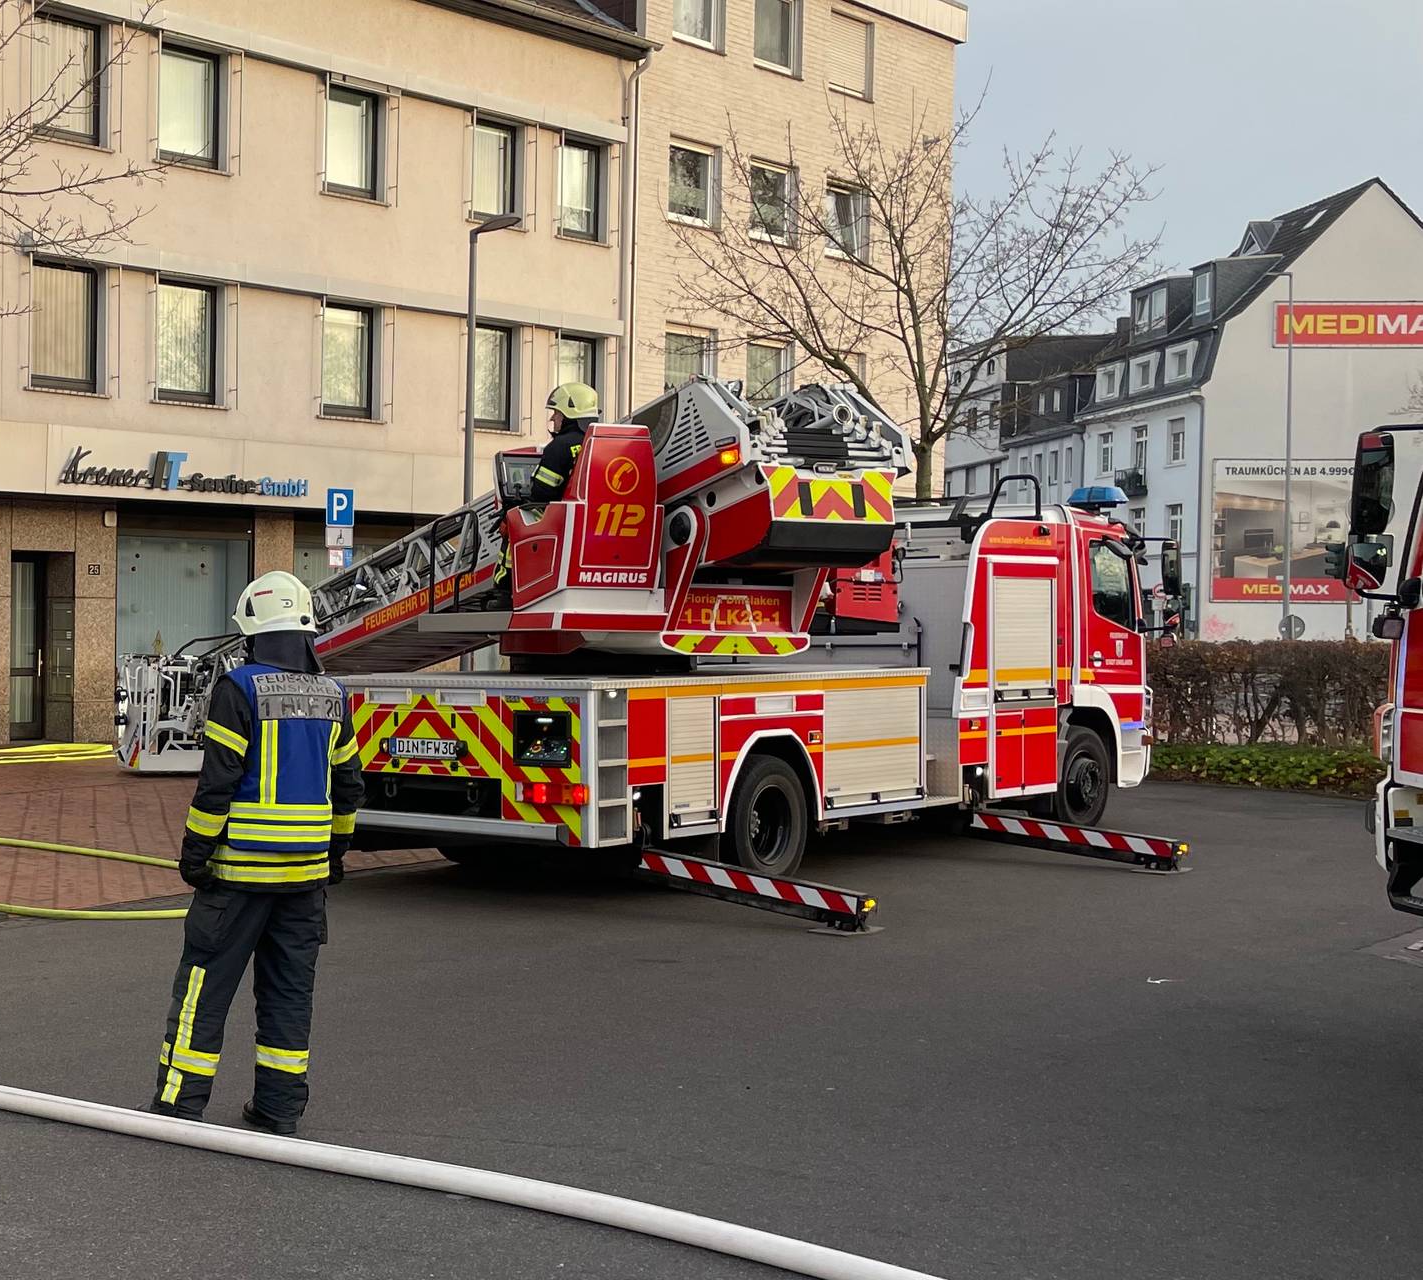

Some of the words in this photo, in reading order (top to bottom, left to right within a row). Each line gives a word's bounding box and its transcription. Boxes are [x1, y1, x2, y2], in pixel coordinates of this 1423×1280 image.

[61, 446, 148, 487] Kremer
[260, 476, 309, 497] GmbH
[1303, 467, 1317, 476] AB
[332, 492, 348, 521] P
[594, 503, 646, 537] 112
[89, 565, 99, 575] 25
[578, 572, 647, 583] MAGIRUS
[1242, 583, 1329, 595] MEDMAX
[365, 597, 418, 632] FEUERWEHR
[684, 608, 692, 624] 1
[700, 608, 780, 626] DLK23-1
[260, 698, 270, 717] 1
[325, 698, 342, 718] 20
[397, 740, 419, 753] DIN
